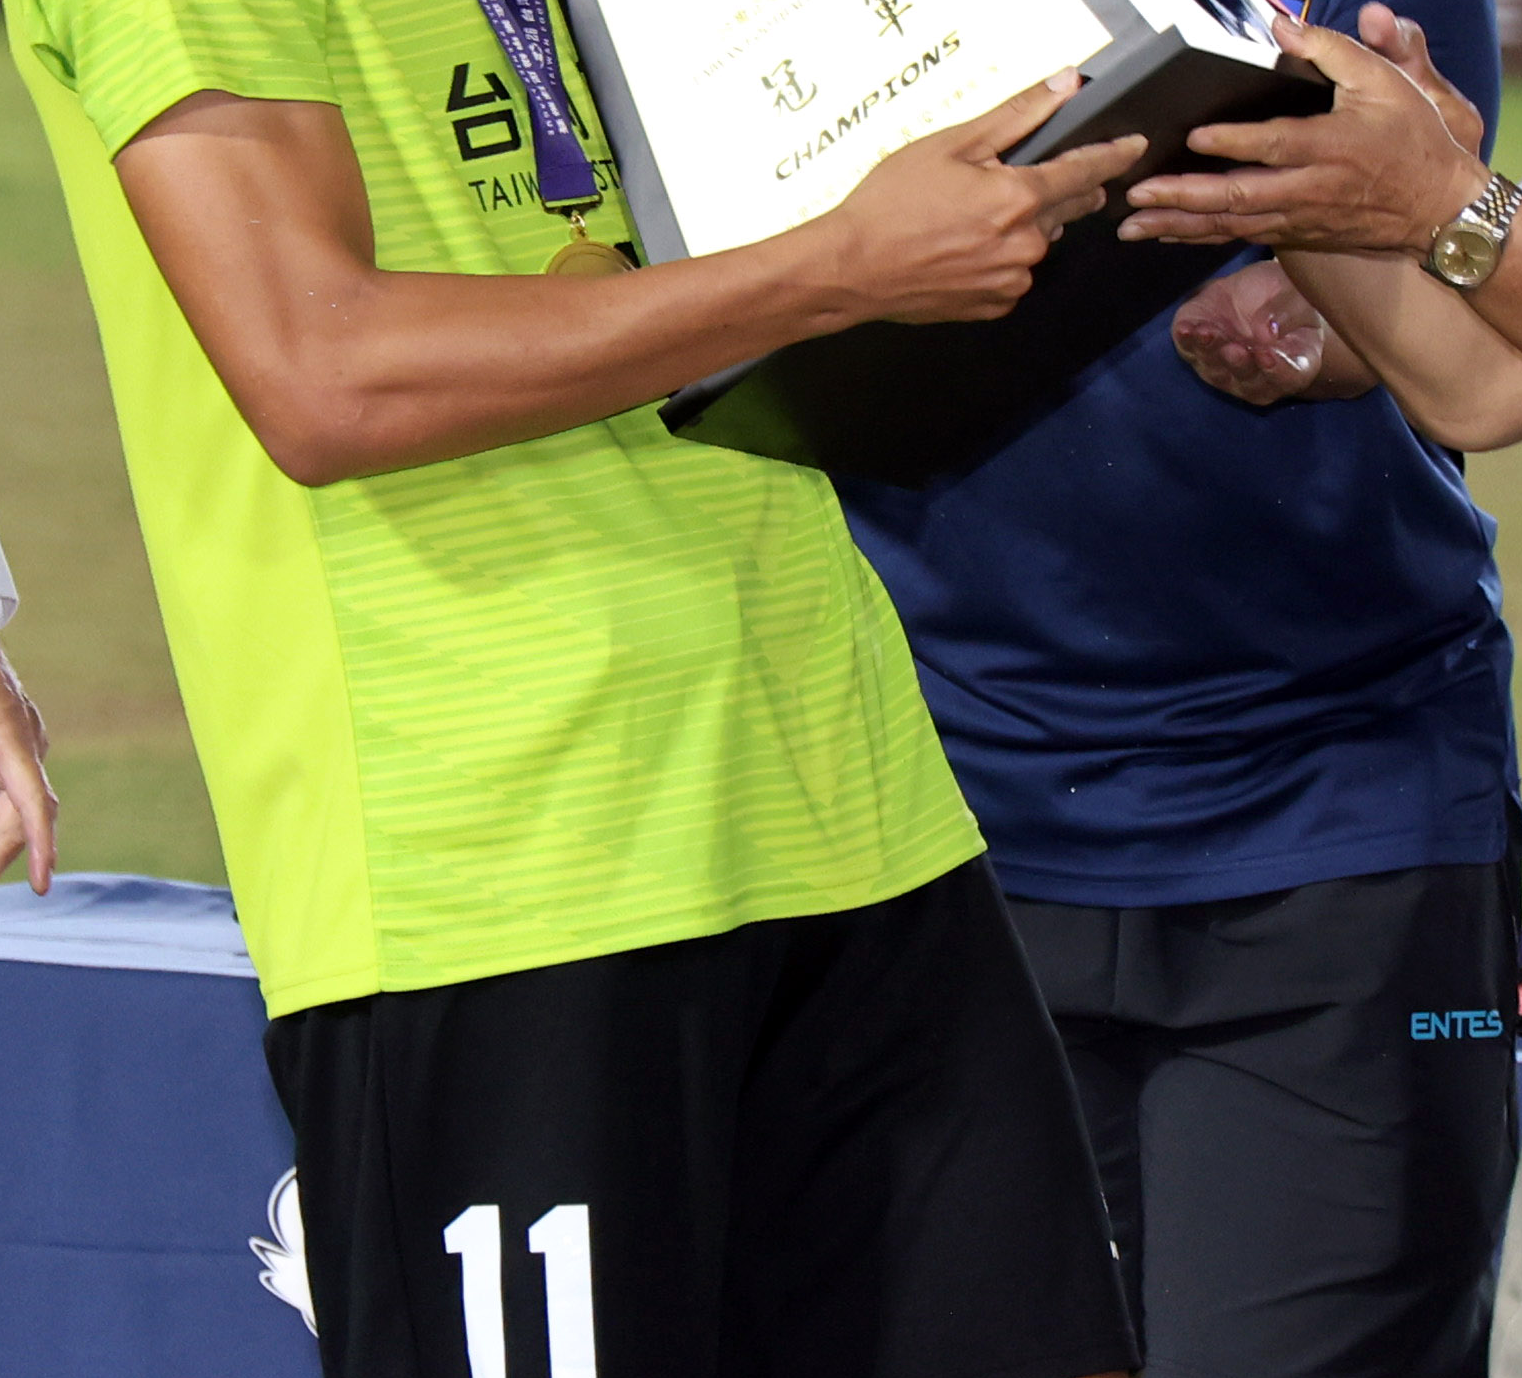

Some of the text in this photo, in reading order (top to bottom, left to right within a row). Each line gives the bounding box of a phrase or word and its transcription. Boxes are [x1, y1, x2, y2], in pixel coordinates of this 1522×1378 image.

[775, 29, 962, 181] CHAMPIONS
[468, 171, 542, 213] TAIW
[1410, 1010, 1503, 1041] ENTES
